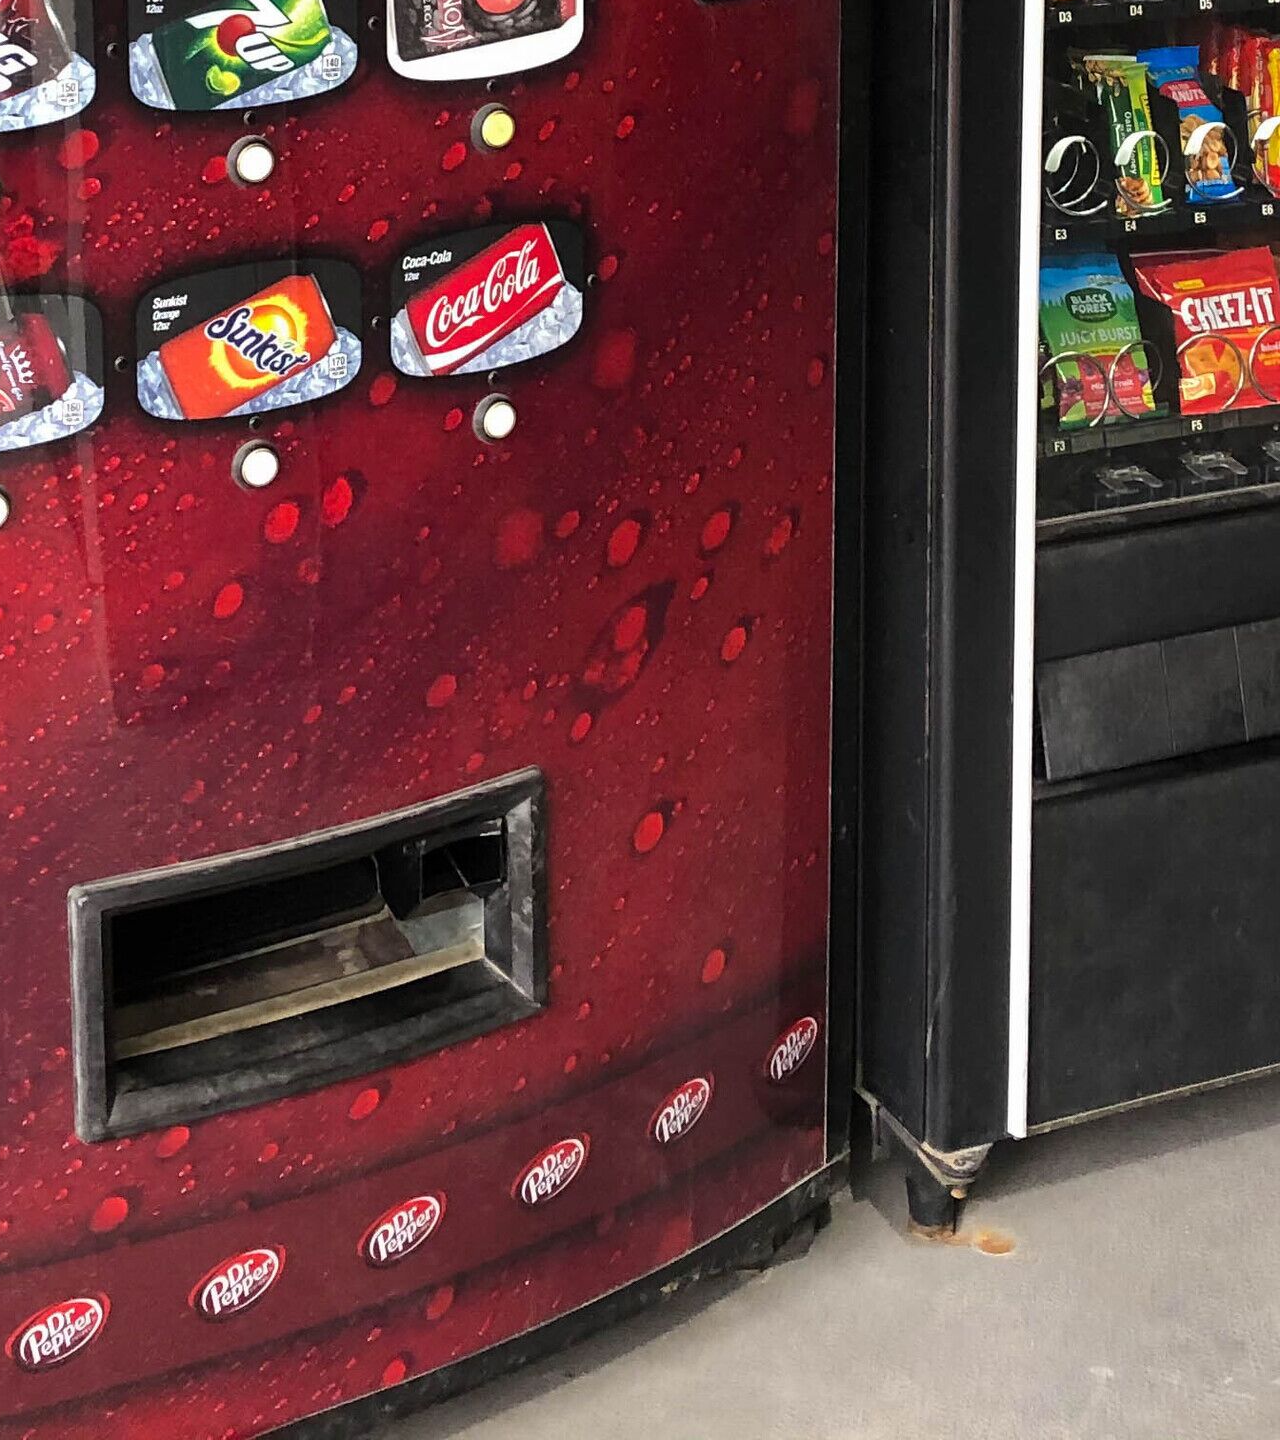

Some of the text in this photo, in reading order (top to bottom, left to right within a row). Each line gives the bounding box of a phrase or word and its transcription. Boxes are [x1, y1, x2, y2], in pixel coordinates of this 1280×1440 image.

[145, 4, 164, 15] 12oz
[1058, 11, 1072, 24] D3
[1129, 4, 1143, 17] D4
[325, 56, 339, 67] 140
[60, 81, 77, 93] 150
[1124, 111, 1133, 133] Oats
[1194, 212, 1206, 224] E5
[1262, 204, 1274, 216] E6
[1055, 229, 1067, 241] E3
[1125, 220, 1136, 232] E4
[402, 250, 453, 270] Coca-Cola
[403, 272, 420, 282] 12oz
[152, 294, 189, 310] Sunkist
[425, 238, 540, 348] Coca-Cola
[1070, 294, 1109, 304] BLACK
[152, 310, 180, 321] Orange
[1071, 302, 1115, 315] FOREST
[1179, 287, 1276, 333] CHEEZ-IT
[152, 321, 171, 332] 12oz
[206, 307, 309, 375] Sunkist
[1060, 325, 1139, 348] JUICY BURST
[330, 356, 346, 367] 170
[1191, 420, 1203, 432] F5
[1054, 440, 1066, 452] F3
[786, 1026, 803, 1050] Dr
[771, 1023, 815, 1080] Pepper
[674, 1088, 693, 1110] Dr
[656, 1086, 706, 1143] Pepper
[541, 1148, 566, 1174] Dr
[522, 1148, 581, 1204] Pepper
[392, 1204, 418, 1230] Dr
[369, 1206, 435, 1262] Pepper
[227, 1258, 255, 1285] Dr
[202, 1258, 274, 1315] Pepper
[46, 1306, 76, 1333] Dr
[20, 1308, 97, 1364] Pepper
